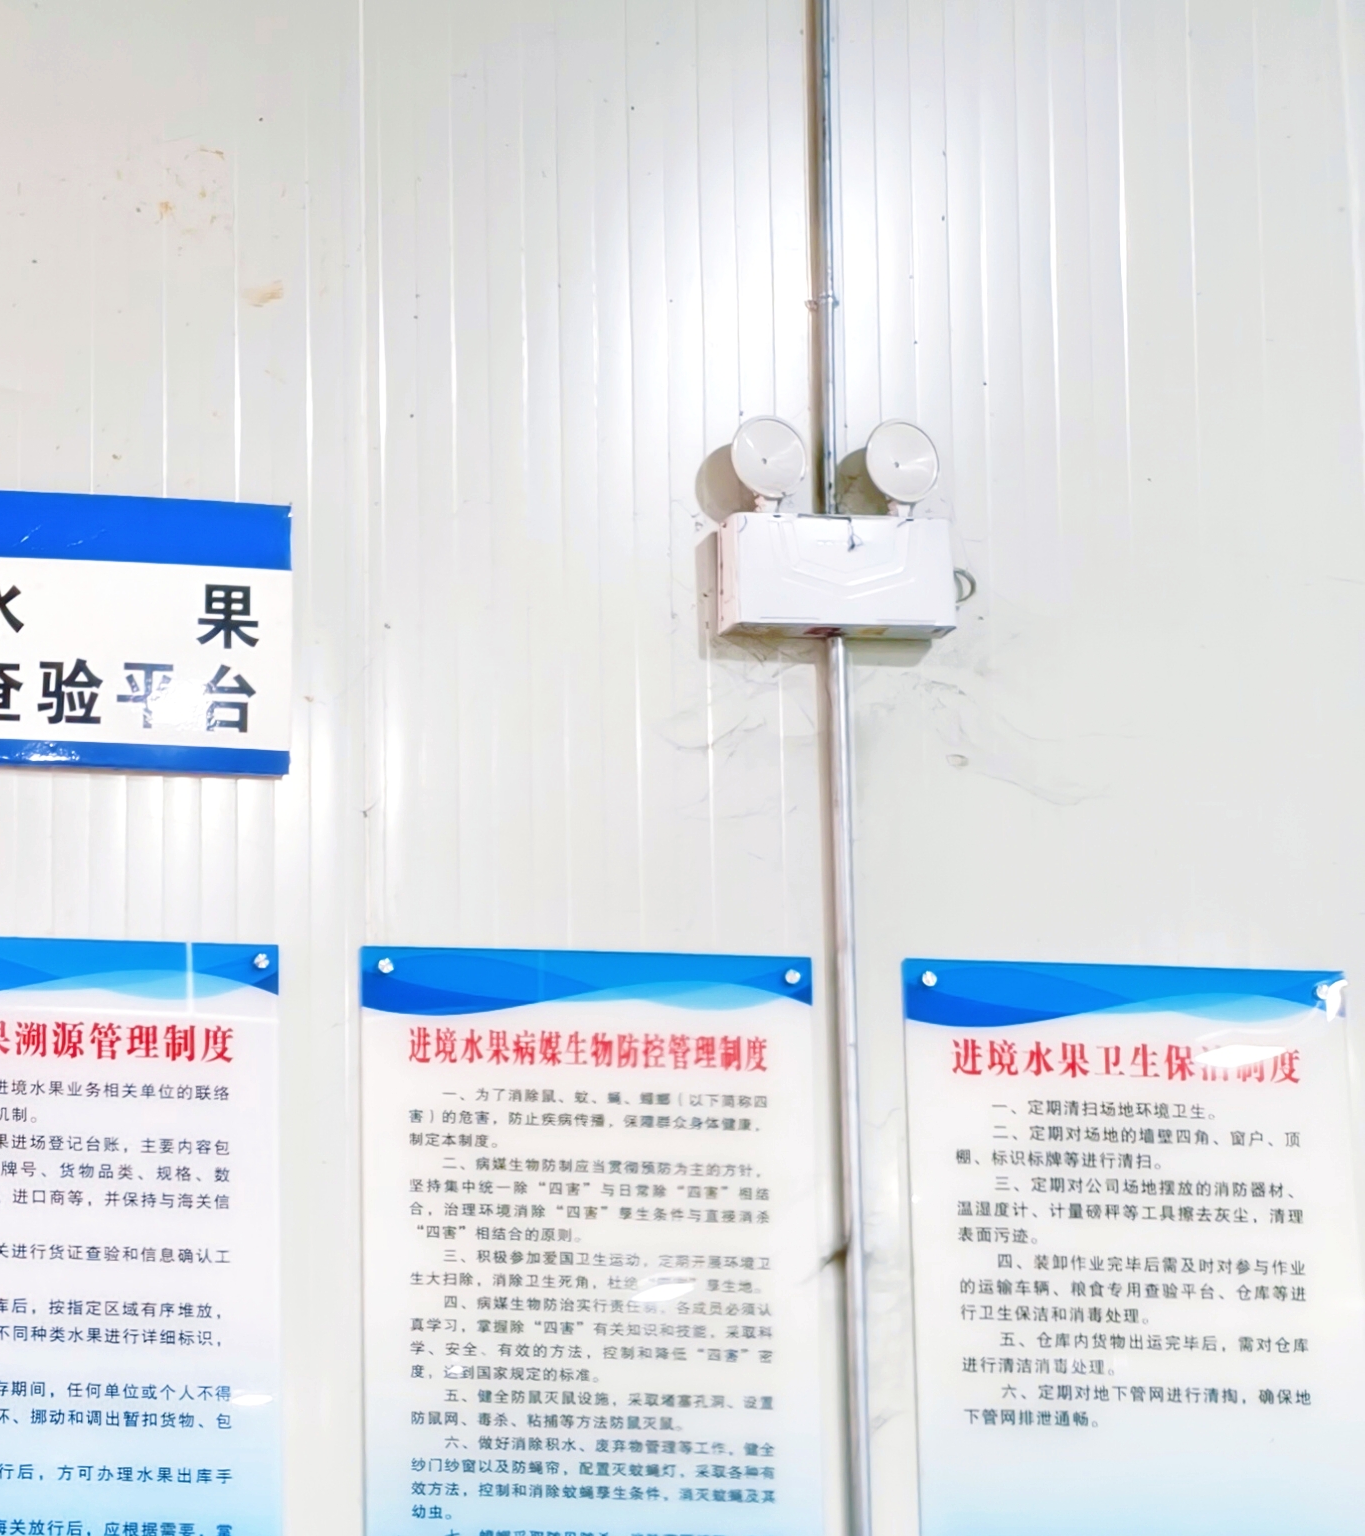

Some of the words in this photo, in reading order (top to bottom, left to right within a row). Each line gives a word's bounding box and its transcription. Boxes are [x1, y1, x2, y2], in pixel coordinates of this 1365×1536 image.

[409, 1028, 767, 1071] 进境水果病媒生物防控管理制度
[992, 1099, 1215, 1119] 一、定期清扫场地环境卫生。
[409, 1132, 497, 1148] 制定本制度。
[993, 1125, 1300, 1147] 二、定期对场地的墙壁四角、窗户、顶
[956, 1149, 1161, 1169] 棚、标识标牌等进行清扫。
[995, 1177, 1293, 1198] 三、定期对公司场地摆放的消防器材、
[957, 1201, 1303, 1224] 温湿度计、计量磅秤等工具擦去灰尘，清理
[958, 1226, 1037, 1244] 表面污迹。
[998, 1254, 1305, 1275] 四、装卸作业完毕后需及时对参与作业
[960, 1278, 1306, 1302] 的运输车辆、粮食专用查验平台、仓库等进
[961, 1304, 1148, 1324] 行卫生保洁和消毒处理。
[1000, 1332, 1308, 1353] 五、仓库内货物出运完毕后，需对仓库
[962, 1357, 1114, 1375] 进行清洁消毒处理。
[1002, 1384, 1311, 1405] 六、定期对地下管网进行清掏，确保地
[964, 1409, 1098, 1427] 下管网排泄通畅。
[412, 1504, 451, 1520] 幼虫。
